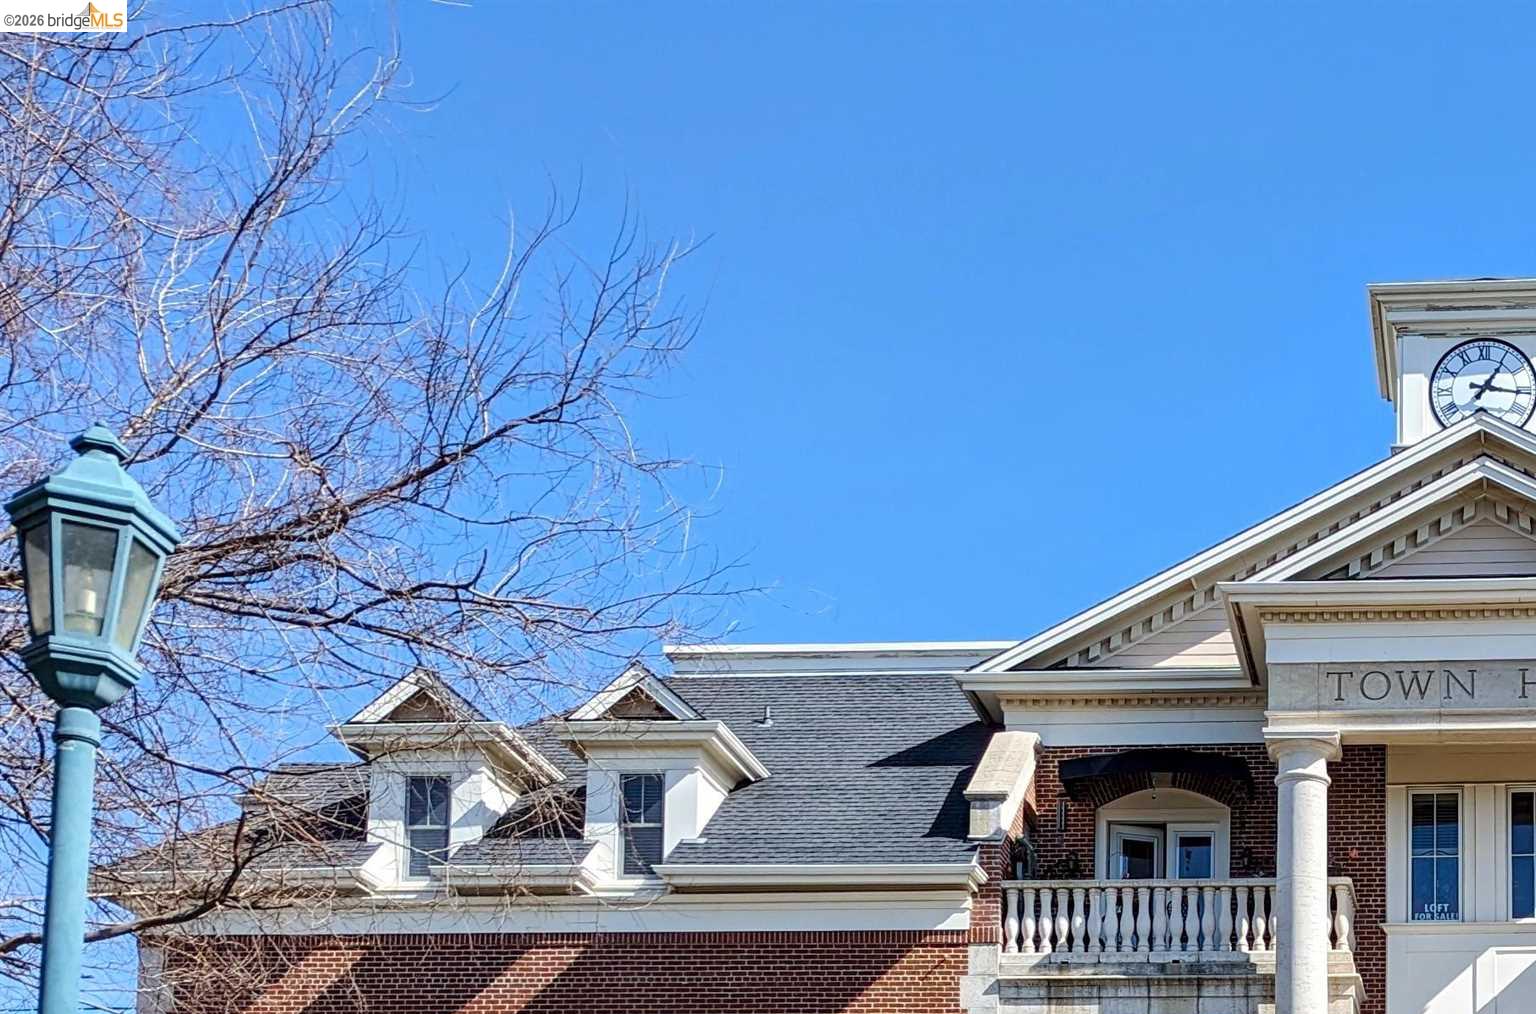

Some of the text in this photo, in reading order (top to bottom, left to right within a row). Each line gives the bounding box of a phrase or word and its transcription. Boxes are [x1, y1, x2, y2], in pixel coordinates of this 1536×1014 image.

[1478, 345, 1491, 361] XII
[1326, 669, 1477, 701] TOWN
[1424, 903, 1449, 912] LOFT
[1414, 912, 1432, 920] FOR
